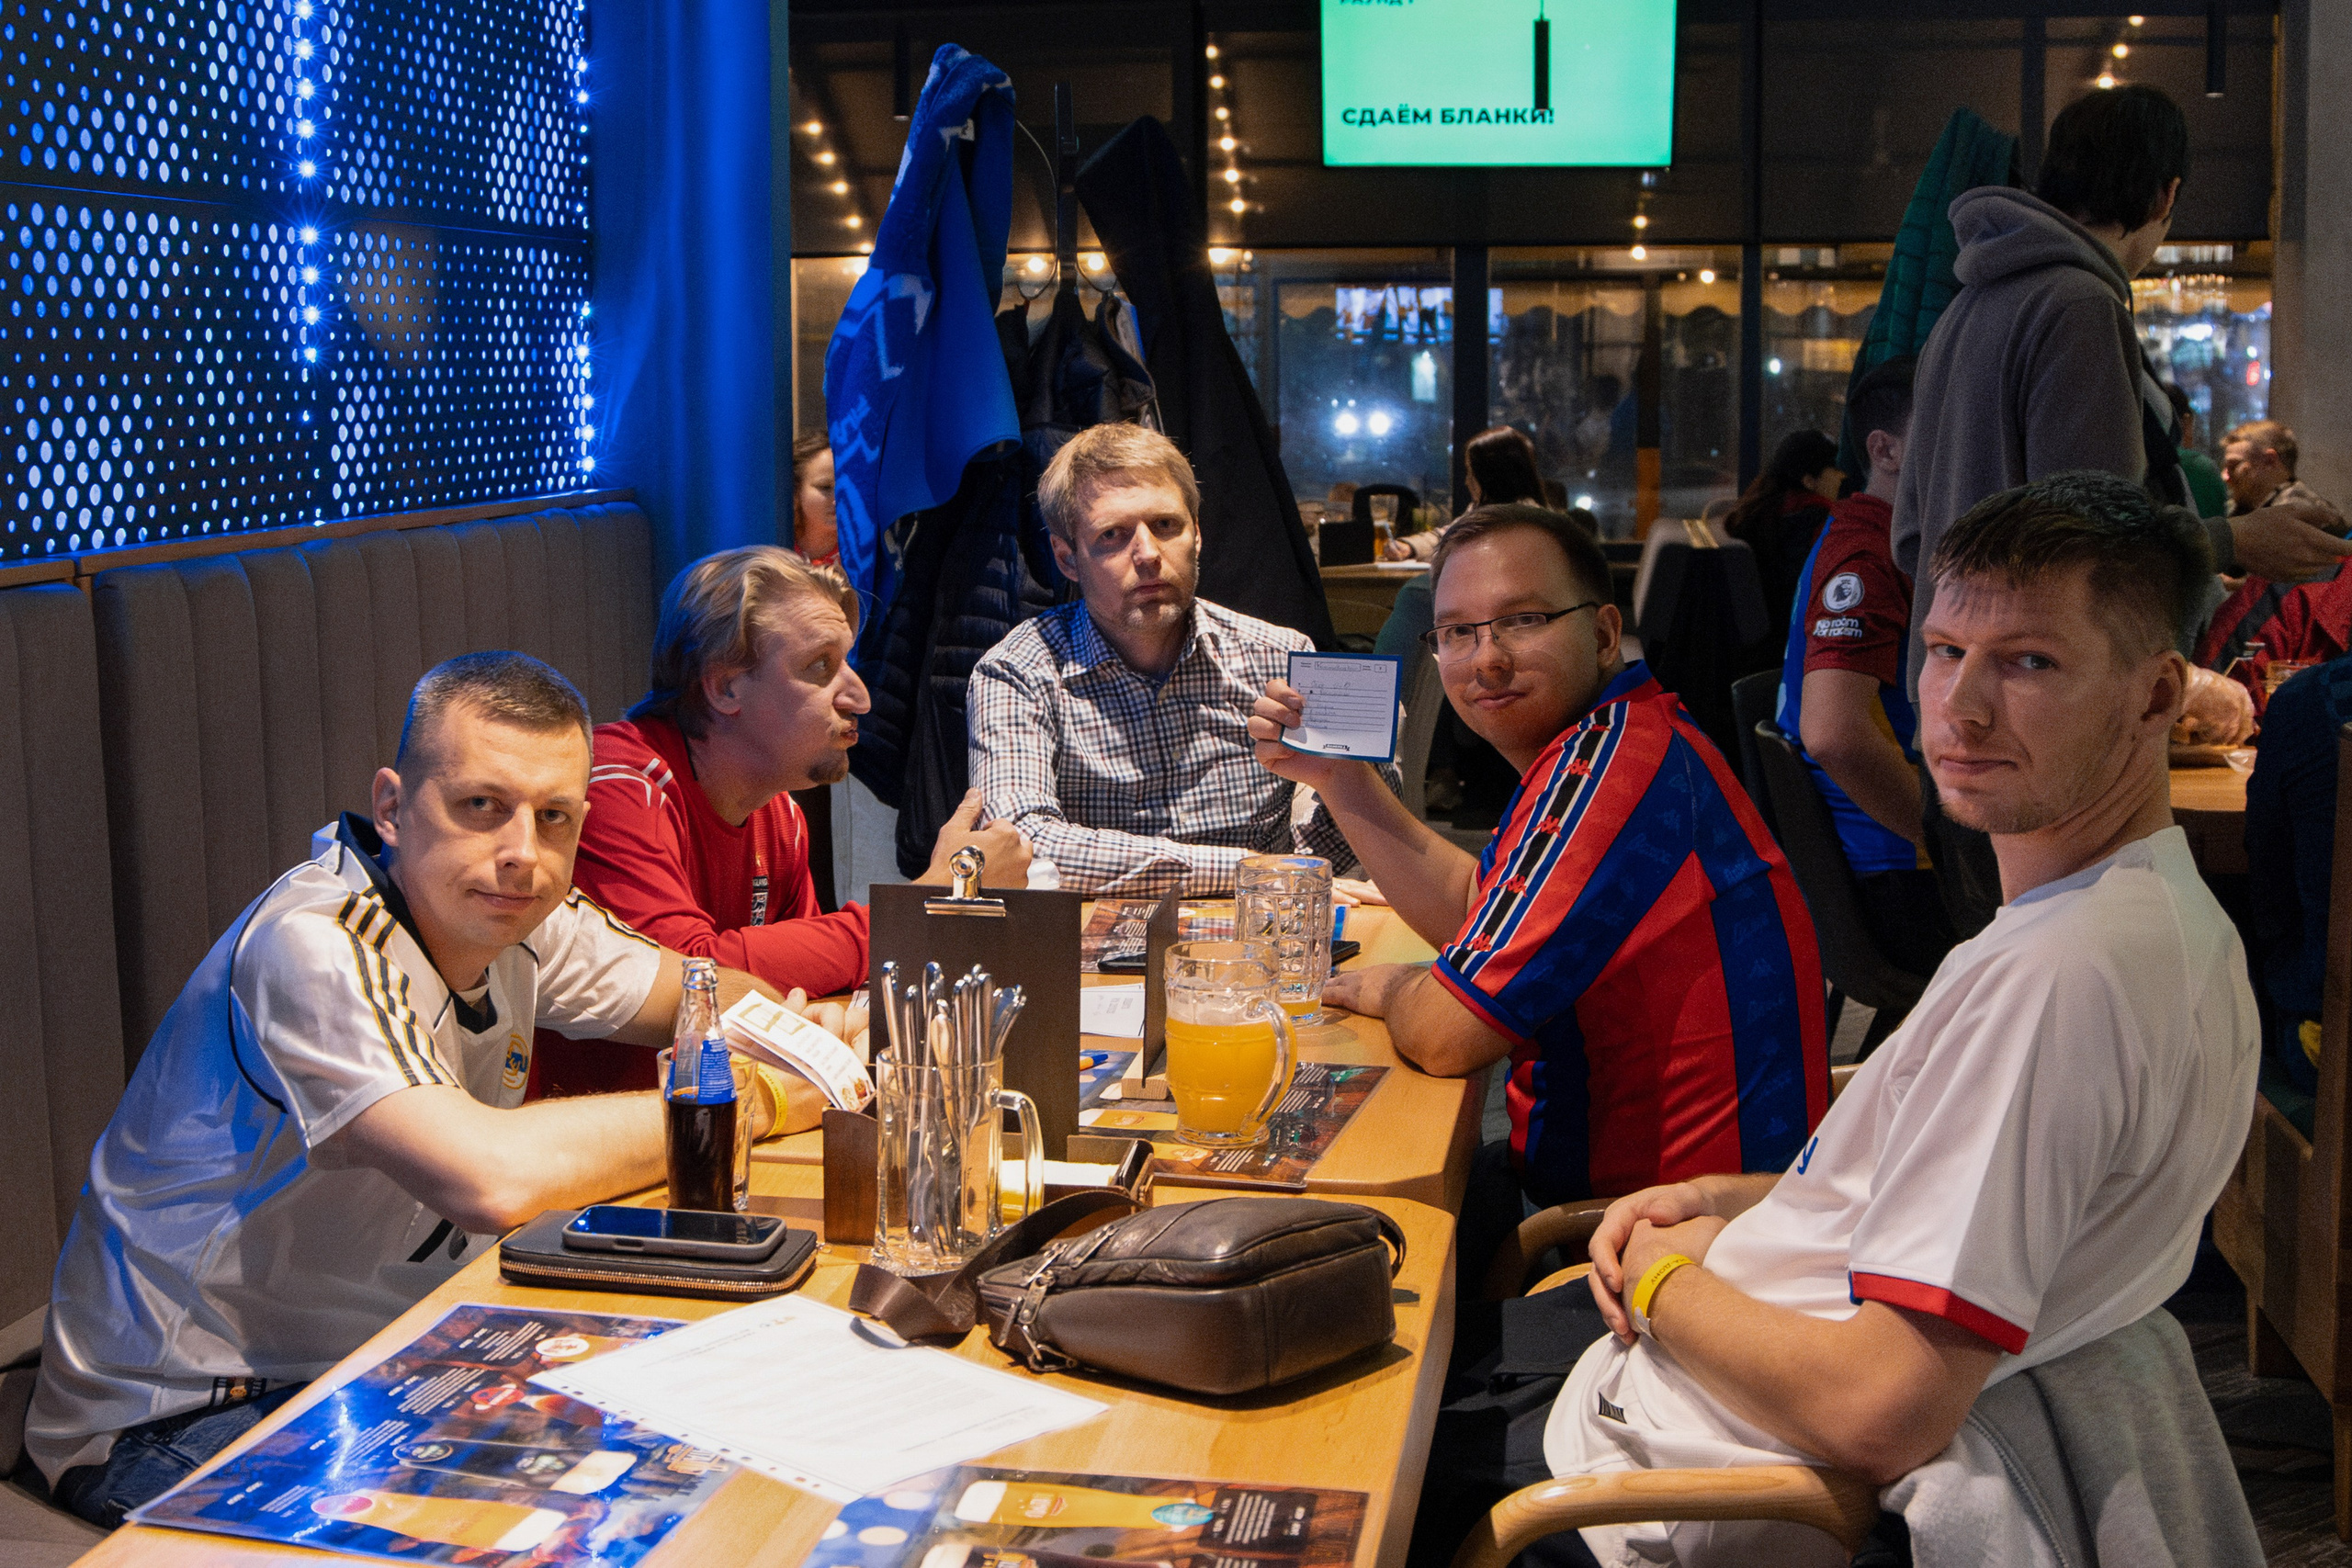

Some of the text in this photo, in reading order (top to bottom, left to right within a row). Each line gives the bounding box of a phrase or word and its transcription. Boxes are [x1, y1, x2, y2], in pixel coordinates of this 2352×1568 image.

[1341, 104, 1555, 126] СДАЁМ БЛАНКИ!
[1831, 617, 1859, 628] room
